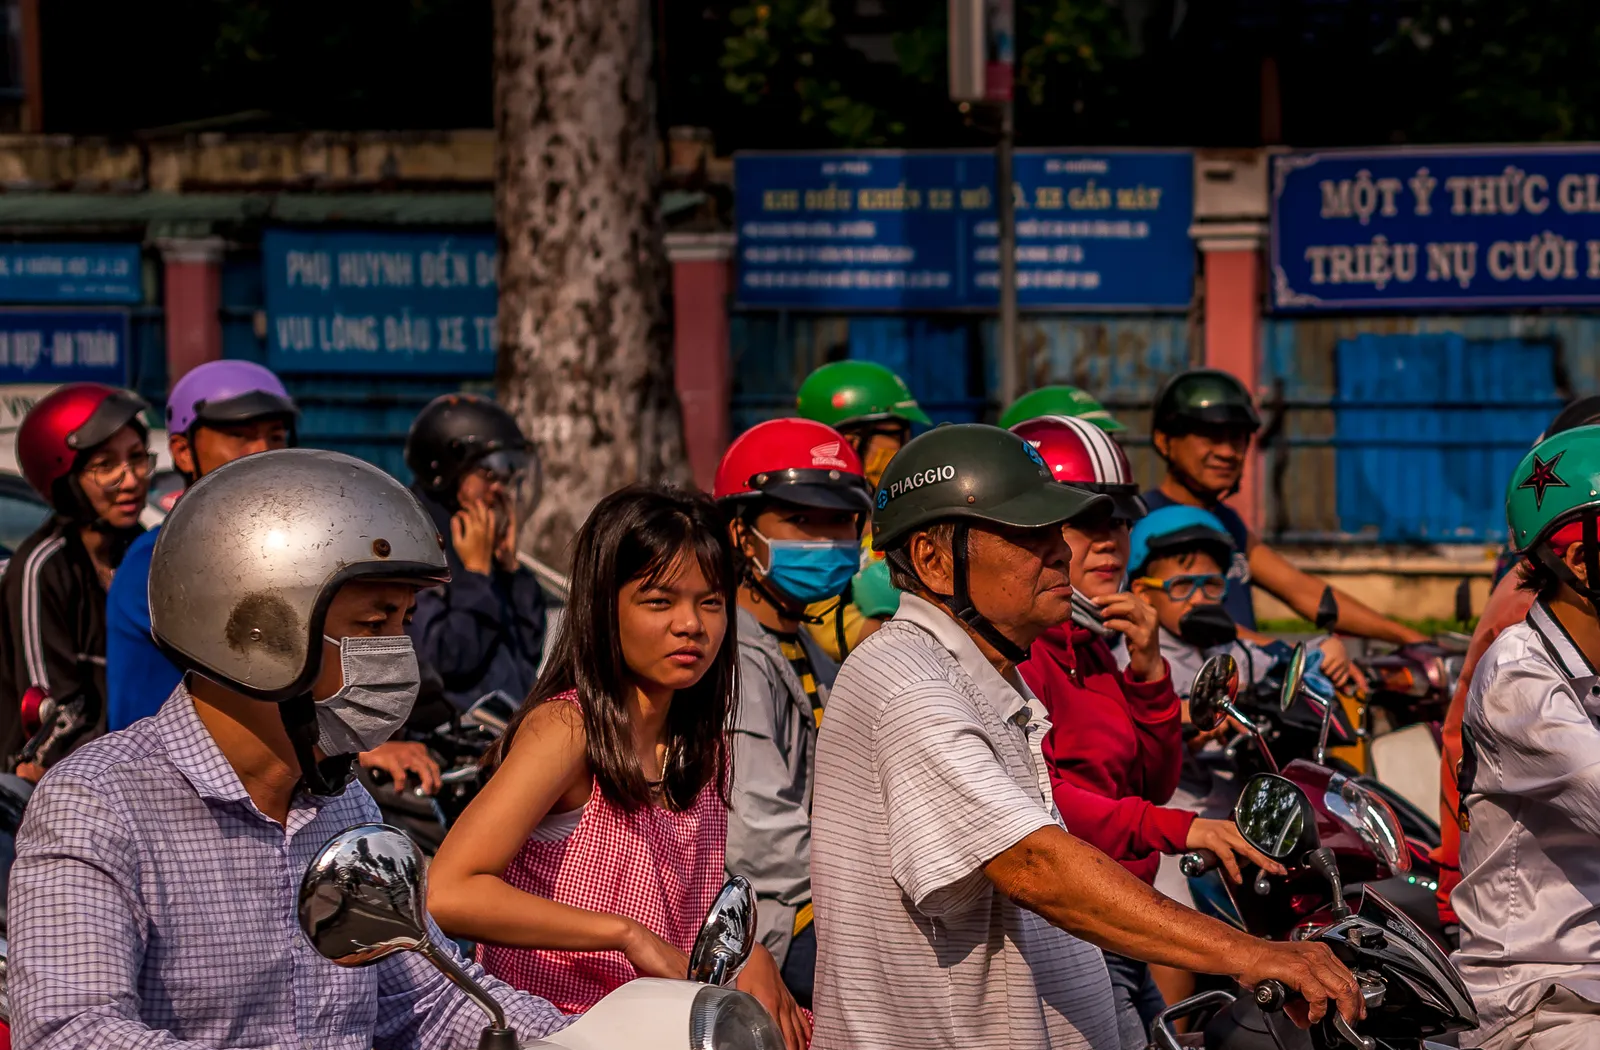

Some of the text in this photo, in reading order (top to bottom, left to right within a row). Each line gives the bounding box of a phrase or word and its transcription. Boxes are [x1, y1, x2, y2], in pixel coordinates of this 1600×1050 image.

[1320, 169, 1401, 224] MỘT
[1410, 168, 1437, 215] Ý
[1446, 166, 1549, 214] THỨC
[1305, 235, 1418, 290] TRIỆU
[1426, 242, 1477, 288] NỤ
[1487, 229, 1578, 281] CƯỜI
[437, 316, 467, 352] XE
[889, 464, 956, 499] PIAGGIO
